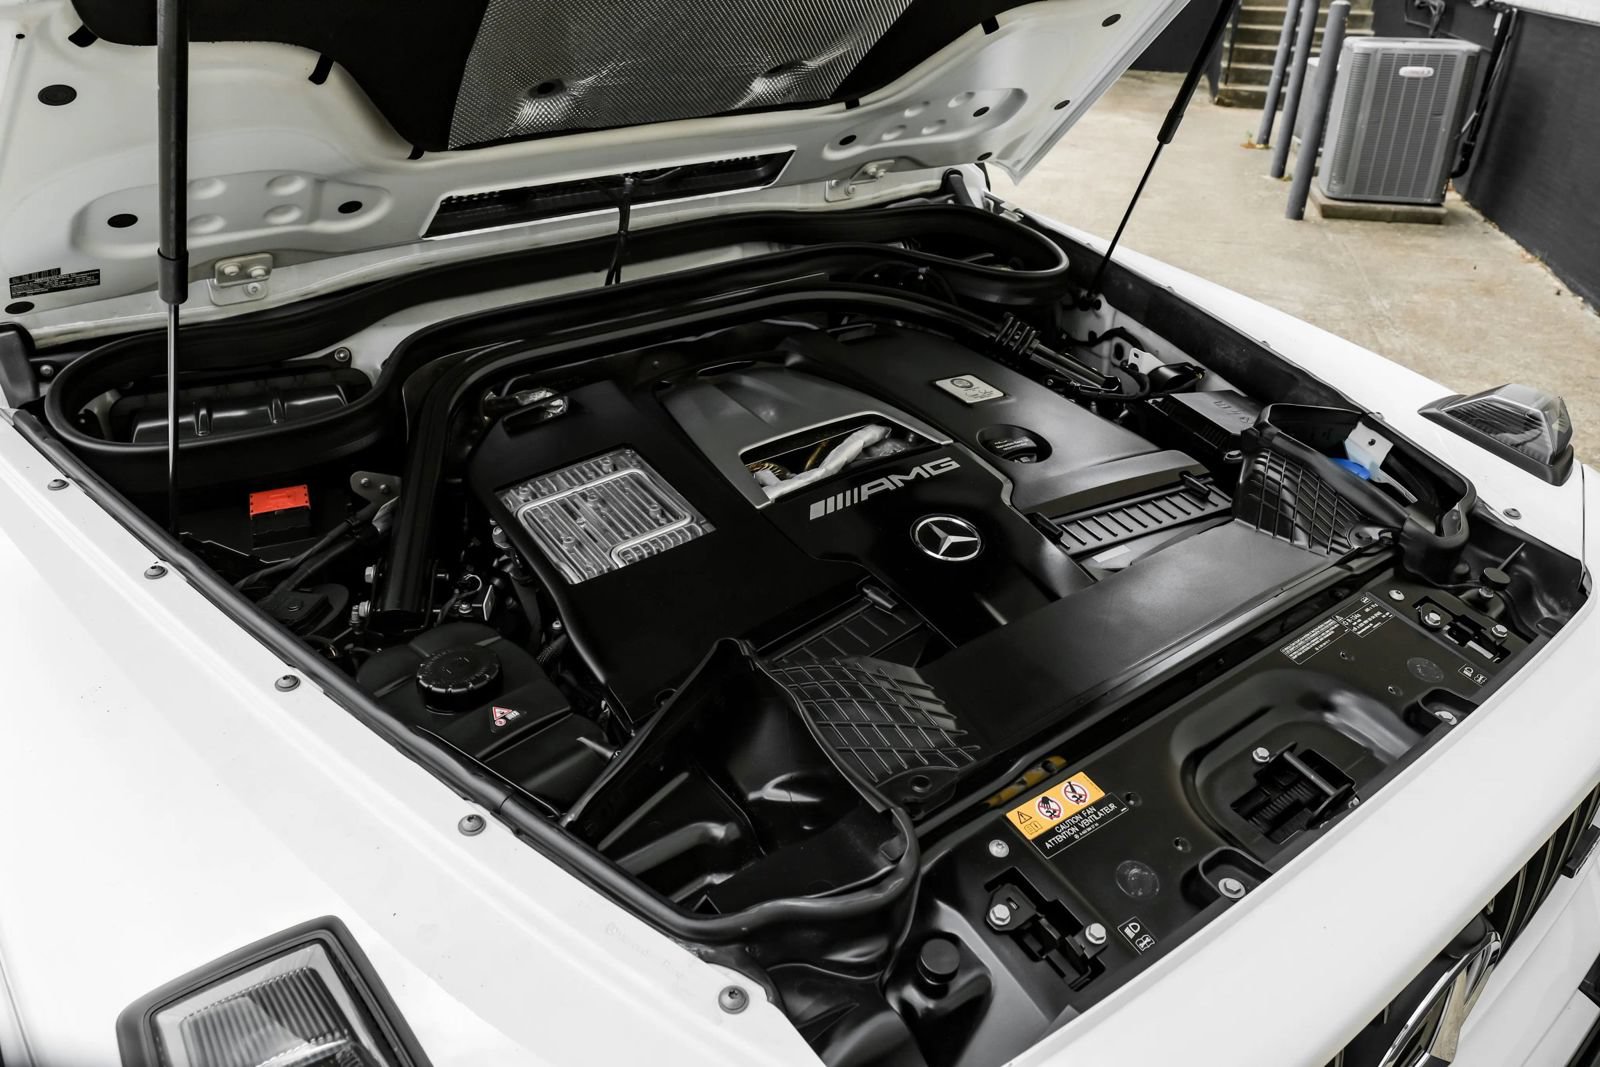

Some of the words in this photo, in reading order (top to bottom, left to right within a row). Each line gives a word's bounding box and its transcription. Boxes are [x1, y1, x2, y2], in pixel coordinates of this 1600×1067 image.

[861, 457, 960, 501] AMG
[1045, 826, 1079, 849] ATTENTION
[1079, 803, 1117, 828] VENTILATEUR
[1055, 814, 1083, 833] CAUTION
[1081, 806, 1097, 817] FAN
